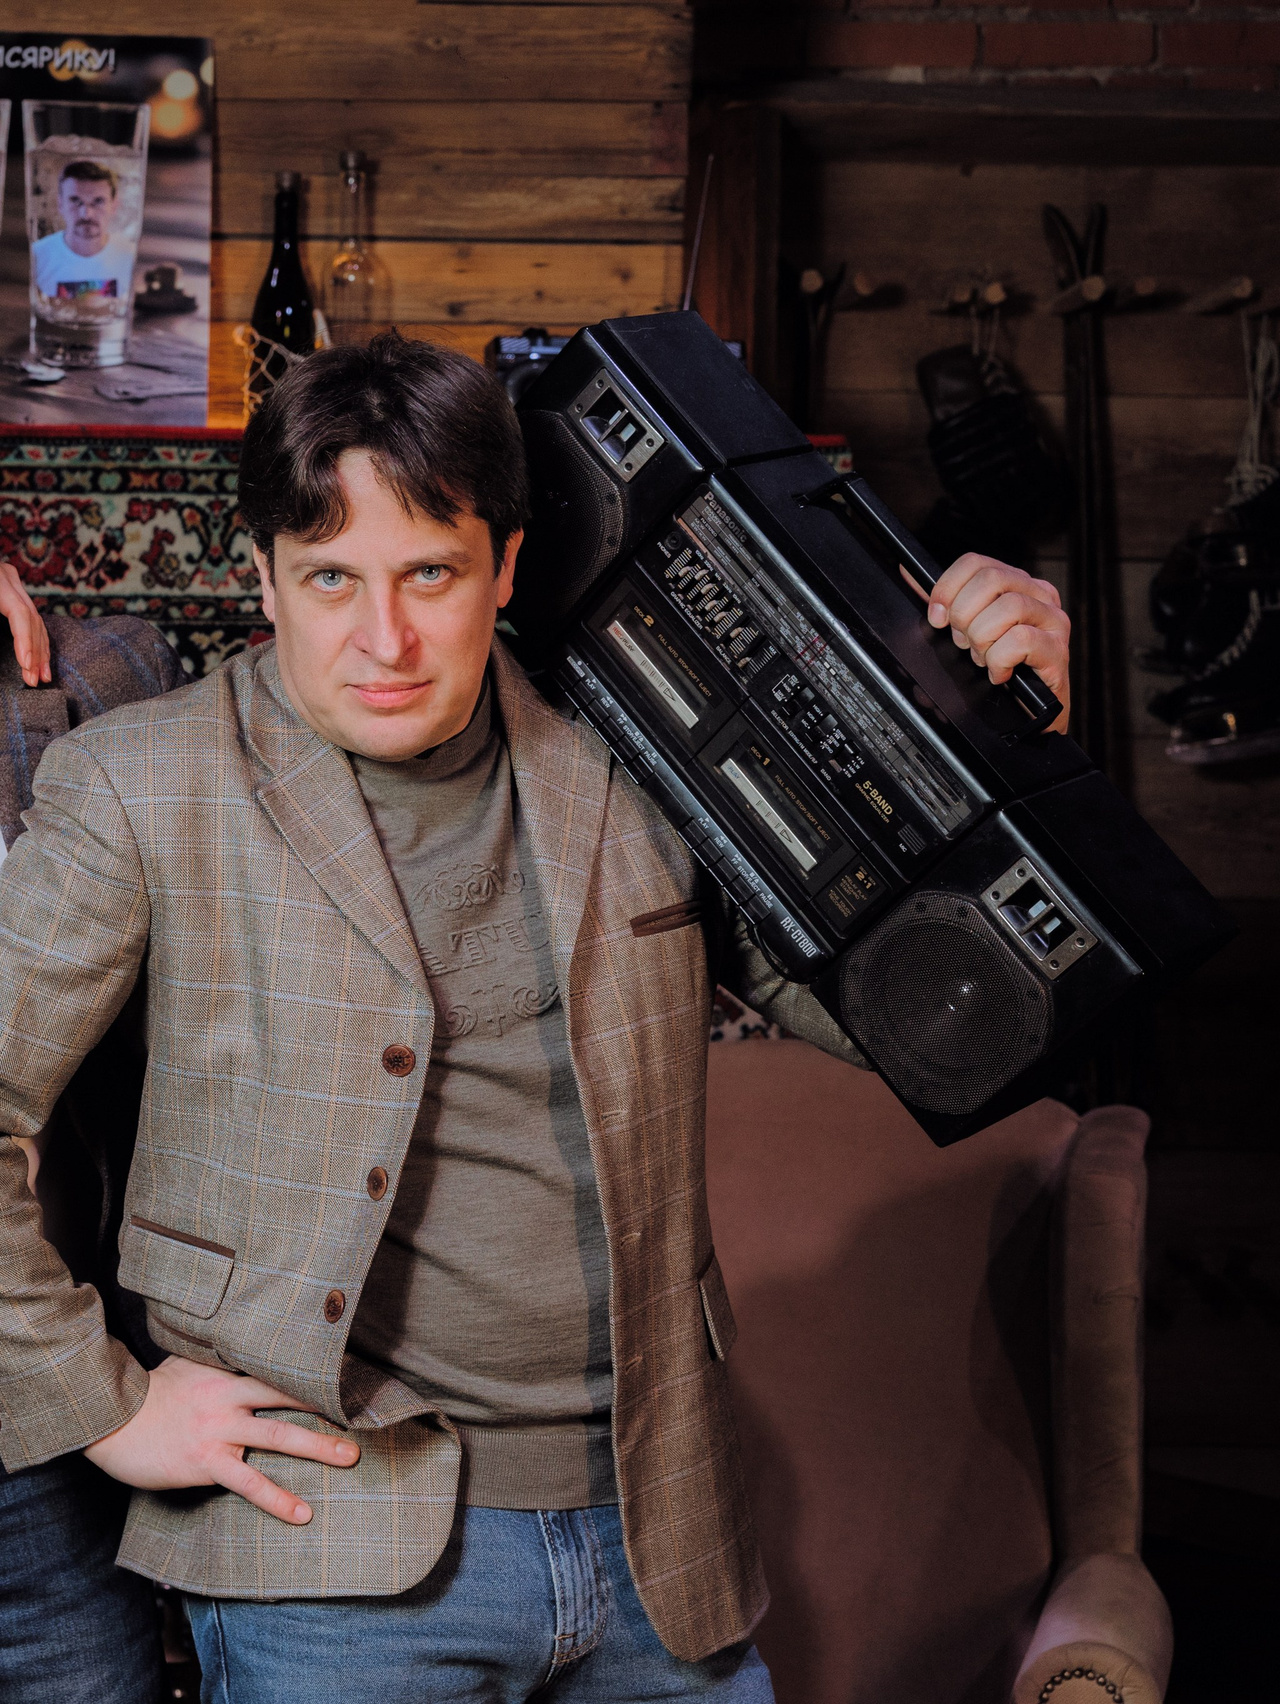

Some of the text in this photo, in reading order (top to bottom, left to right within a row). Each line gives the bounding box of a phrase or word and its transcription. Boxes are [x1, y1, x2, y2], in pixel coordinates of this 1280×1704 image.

[702, 490, 750, 543] Panasonic
[655, 541, 672, 559] PHONES
[632, 604, 656, 628] DECK 2
[669, 590, 704, 630] GRAPHIC EQUALIZER
[610, 625, 635, 653] REC/PLAY
[656, 633, 712, 697] FULL AUTO STOP/SOFT EJECT
[714, 645, 732, 665] BALANCE
[584, 678, 596, 691] PLAY
[599, 697, 611, 709] REW
[615, 717, 625, 726] FF
[769, 709, 790, 731] SELECTOR
[621, 724, 646, 751] STOP/EJECT
[642, 750, 657, 766] PAUSE
[749, 745, 771, 766] DECK 1
[726, 764, 741, 780] PLAY
[819, 767, 832, 781] BAND
[853, 781, 891, 824] GRAPHIC EQUALIZER
[860, 778, 895, 816] 5-BAND
[773, 774, 831, 841] FULL AUTO STOP/SOFT EJECT
[697, 817, 709, 830] PLAY
[713, 836, 725, 849] REW
[897, 842, 908, 853] MIC
[730, 857, 739, 866] FF
[736, 865, 761, 892] STOP/EJECT
[758, 892, 773, 909] PAUSE
[778, 915, 818, 958] RX-CT800
